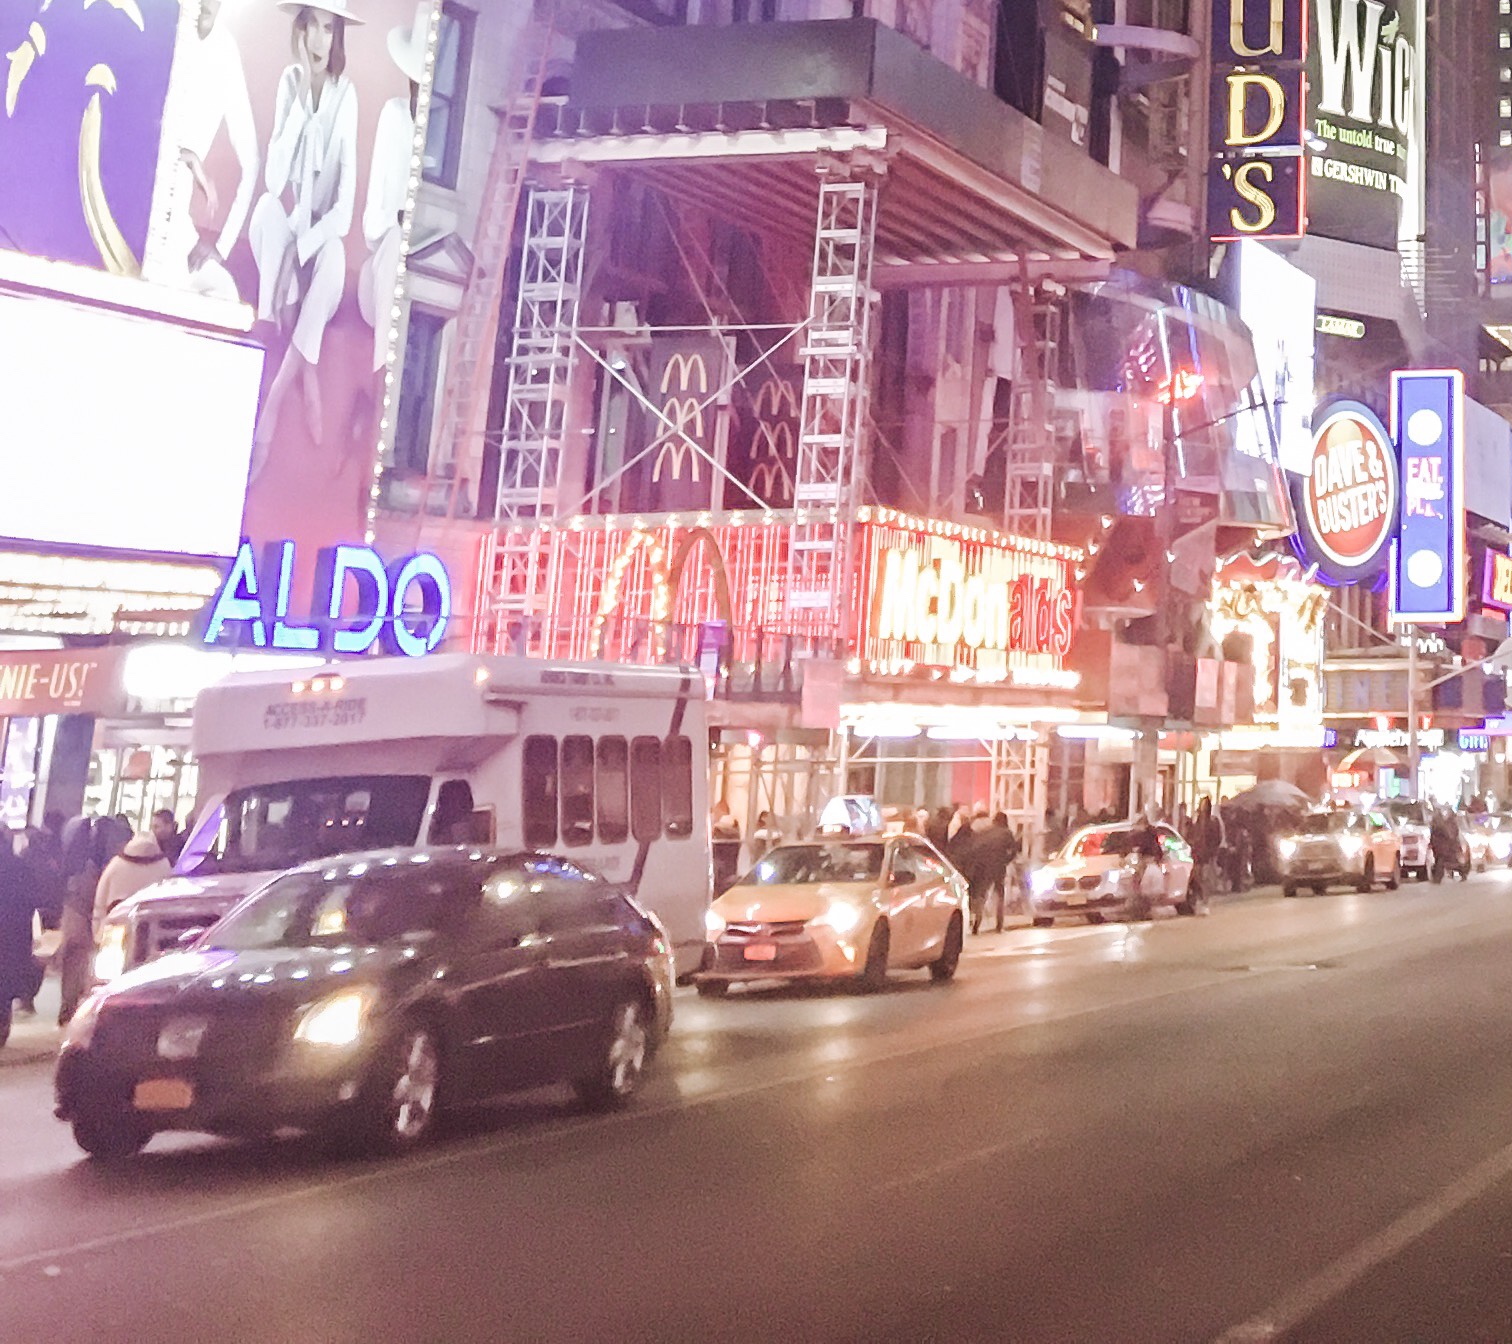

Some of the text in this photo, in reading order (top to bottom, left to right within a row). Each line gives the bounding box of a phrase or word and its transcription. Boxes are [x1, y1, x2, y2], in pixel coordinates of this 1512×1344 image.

[1315, 118, 1337, 141] The
[1338, 127, 1374, 150] untold
[1374, 136, 1396, 156] true
[1323, 158, 1387, 192] GERSHWIN
[1314, 439, 1385, 498] DAVE &
[1316, 479, 1388, 534] BUSTER'S
[203, 540, 451, 657] ALDO
